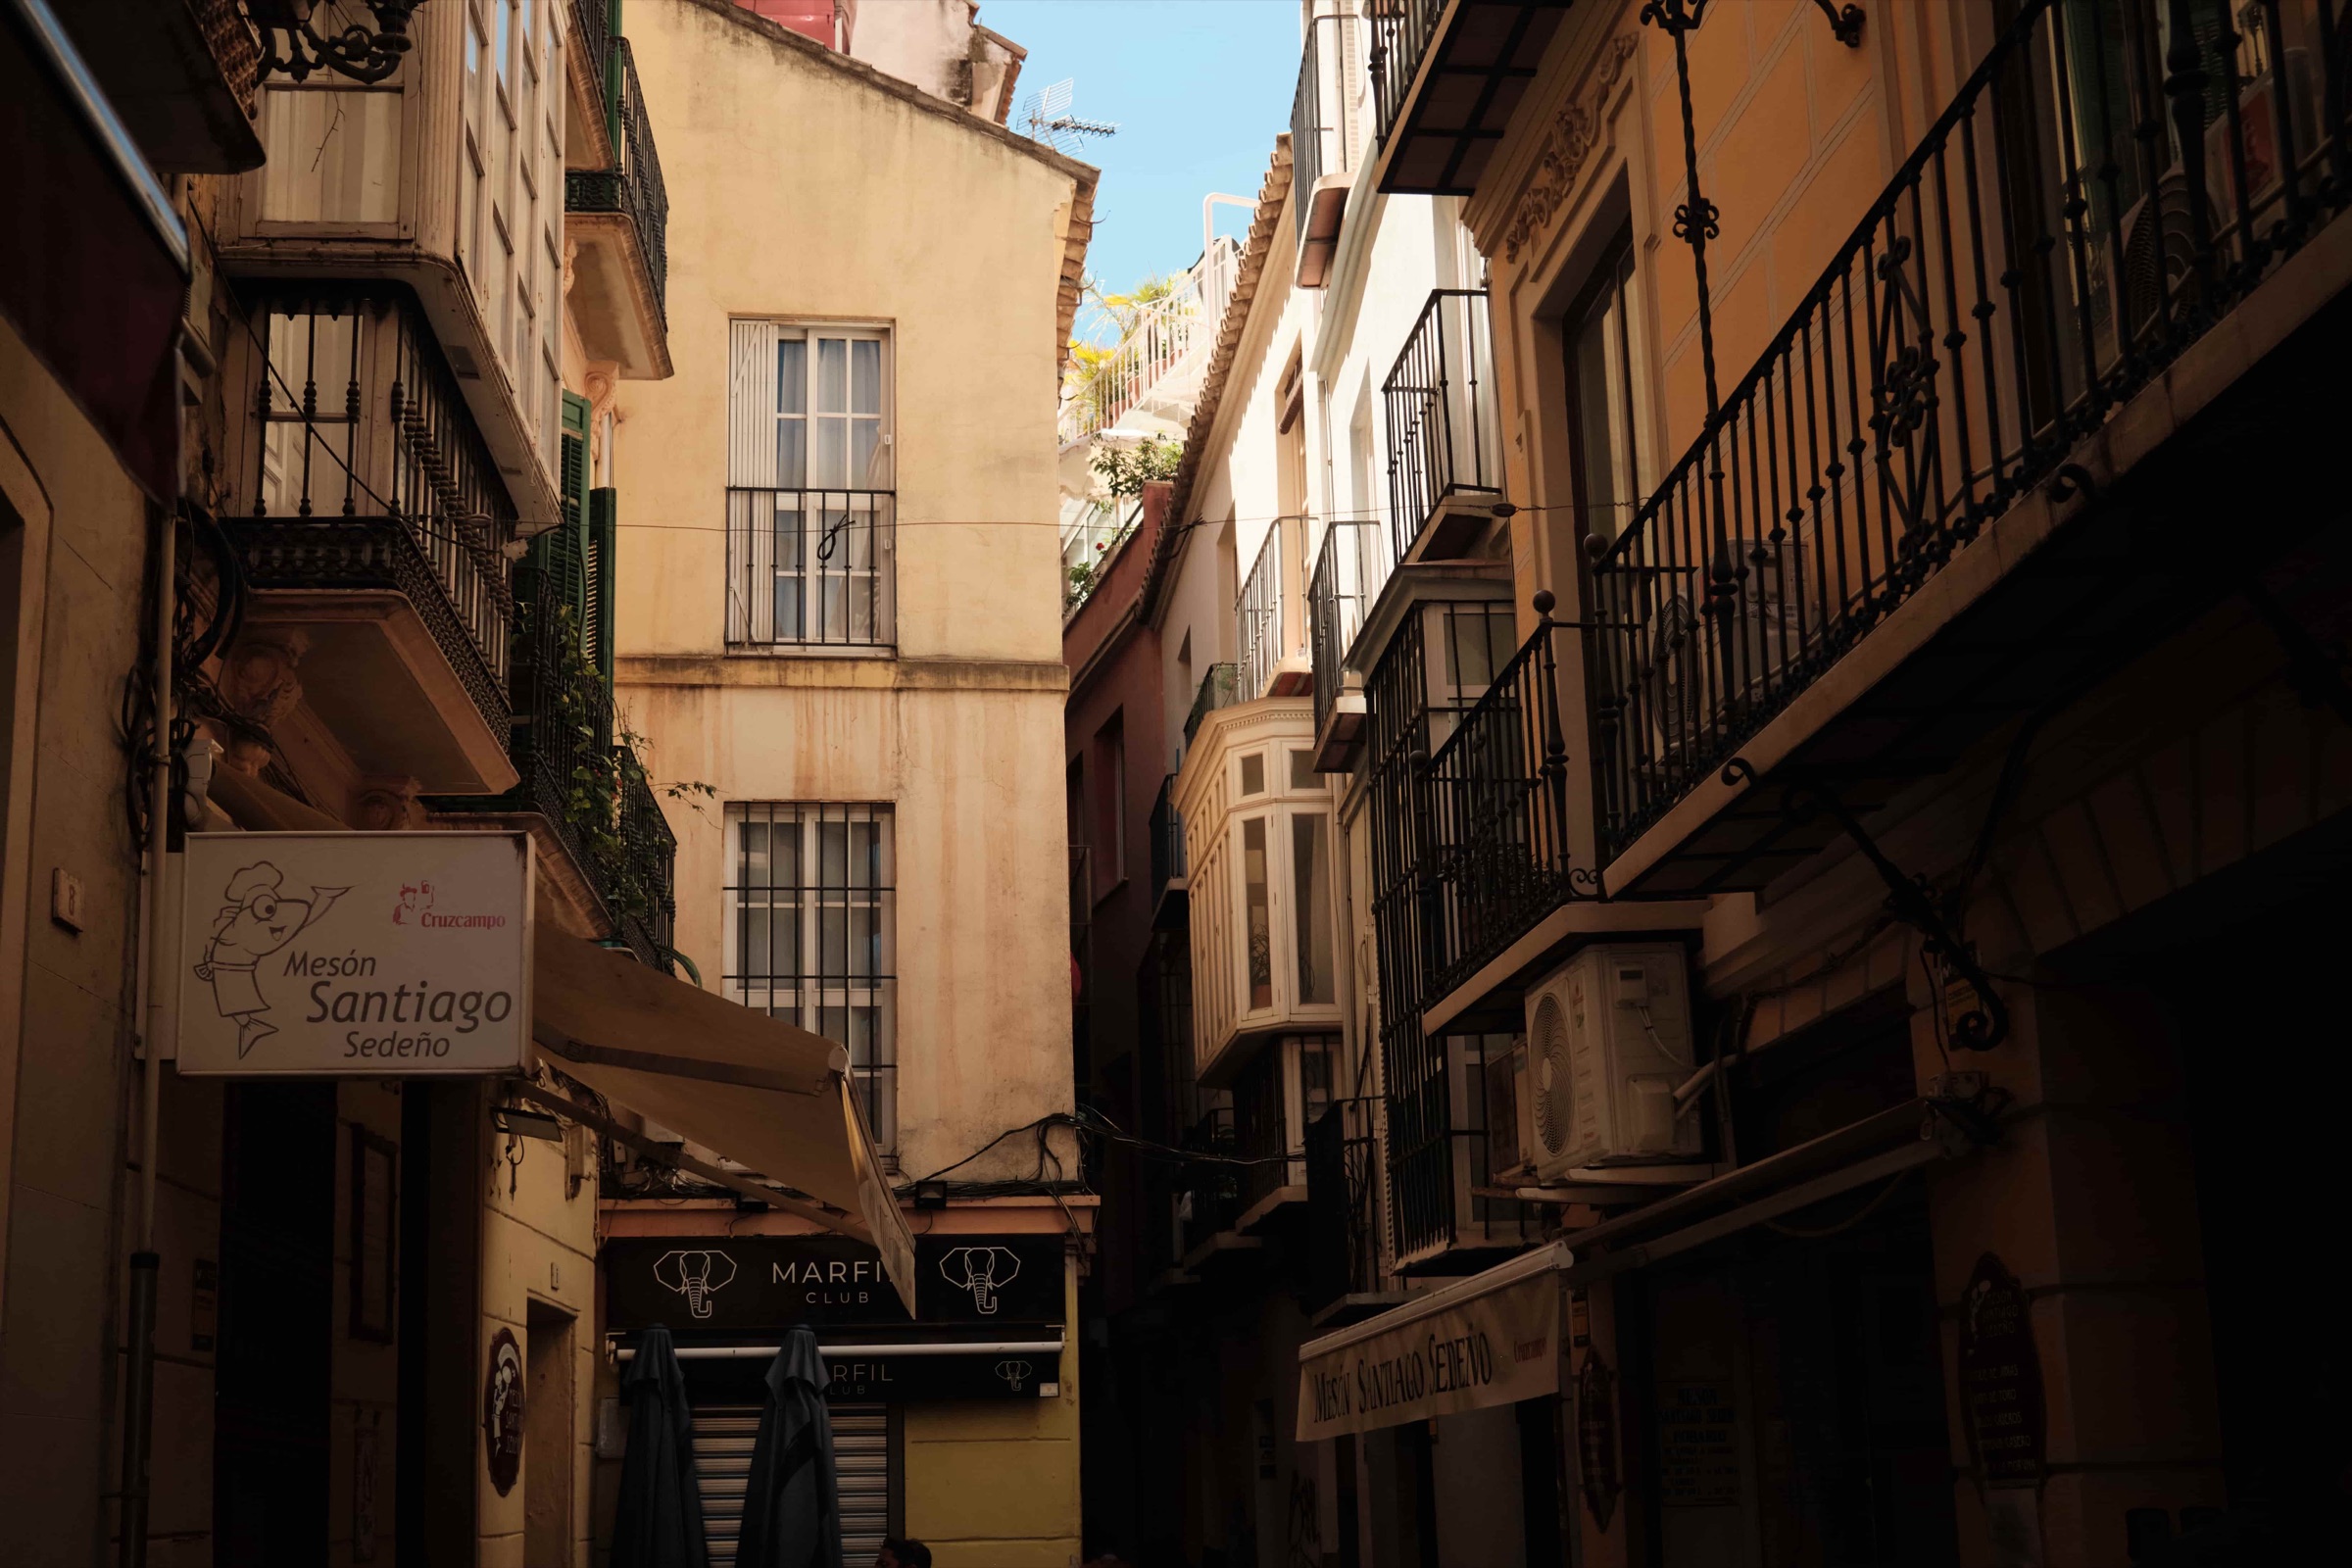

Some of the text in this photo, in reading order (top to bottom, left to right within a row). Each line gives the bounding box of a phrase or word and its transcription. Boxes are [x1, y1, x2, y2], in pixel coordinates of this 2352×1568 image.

[69, 884, 75, 916] 8
[420, 911, 506, 929] Cruzcampo
[283, 949, 376, 977] Mesón
[306, 980, 512, 1034] Santiago
[344, 1031, 450, 1058] Sedeño
[772, 1260, 892, 1284] MARFI
[806, 1292, 869, 1304] CLUB
[833, 1363, 894, 1382] RFIL
[1357, 1349, 1424, 1414] SANTIAGO
[829, 1385, 866, 1396] LUB
